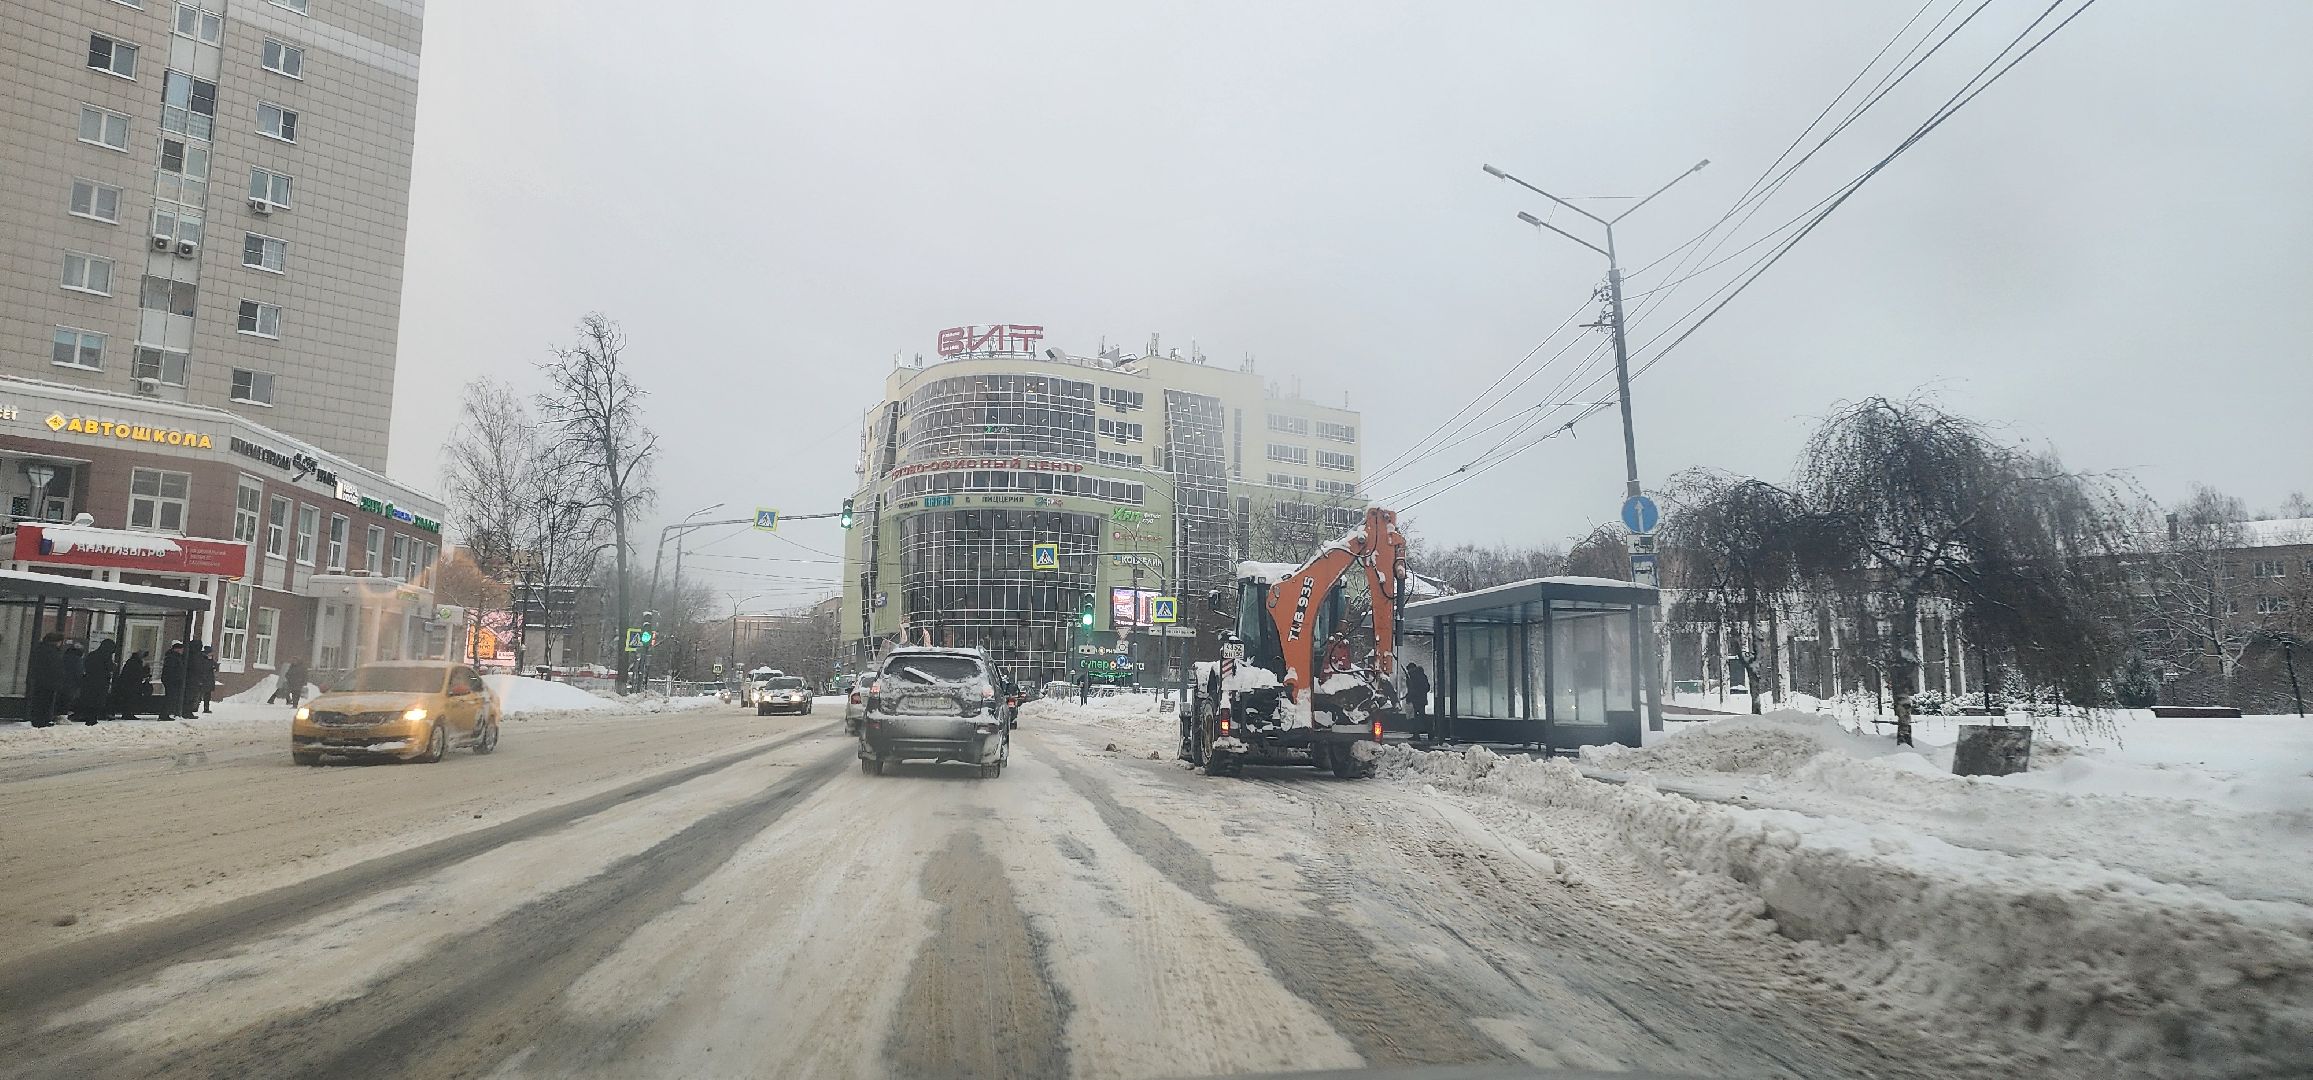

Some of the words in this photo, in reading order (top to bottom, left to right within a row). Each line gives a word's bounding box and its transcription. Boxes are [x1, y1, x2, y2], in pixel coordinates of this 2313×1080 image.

[938, 324, 1043, 356] ВИТ
[0, 409, 18, 420] ЕТ
[67, 417, 213, 449] АВТОШКОЛА
[891, 456, 1021, 481] РГОВО-ОФИСНЫЙ
[1027, 459, 1083, 473] ЦЕНТР
[982, 496, 1024, 504] ПИЦЦЕРИЯ
[1287, 611, 1305, 642] TLB
[1298, 576, 1314, 608] 935
